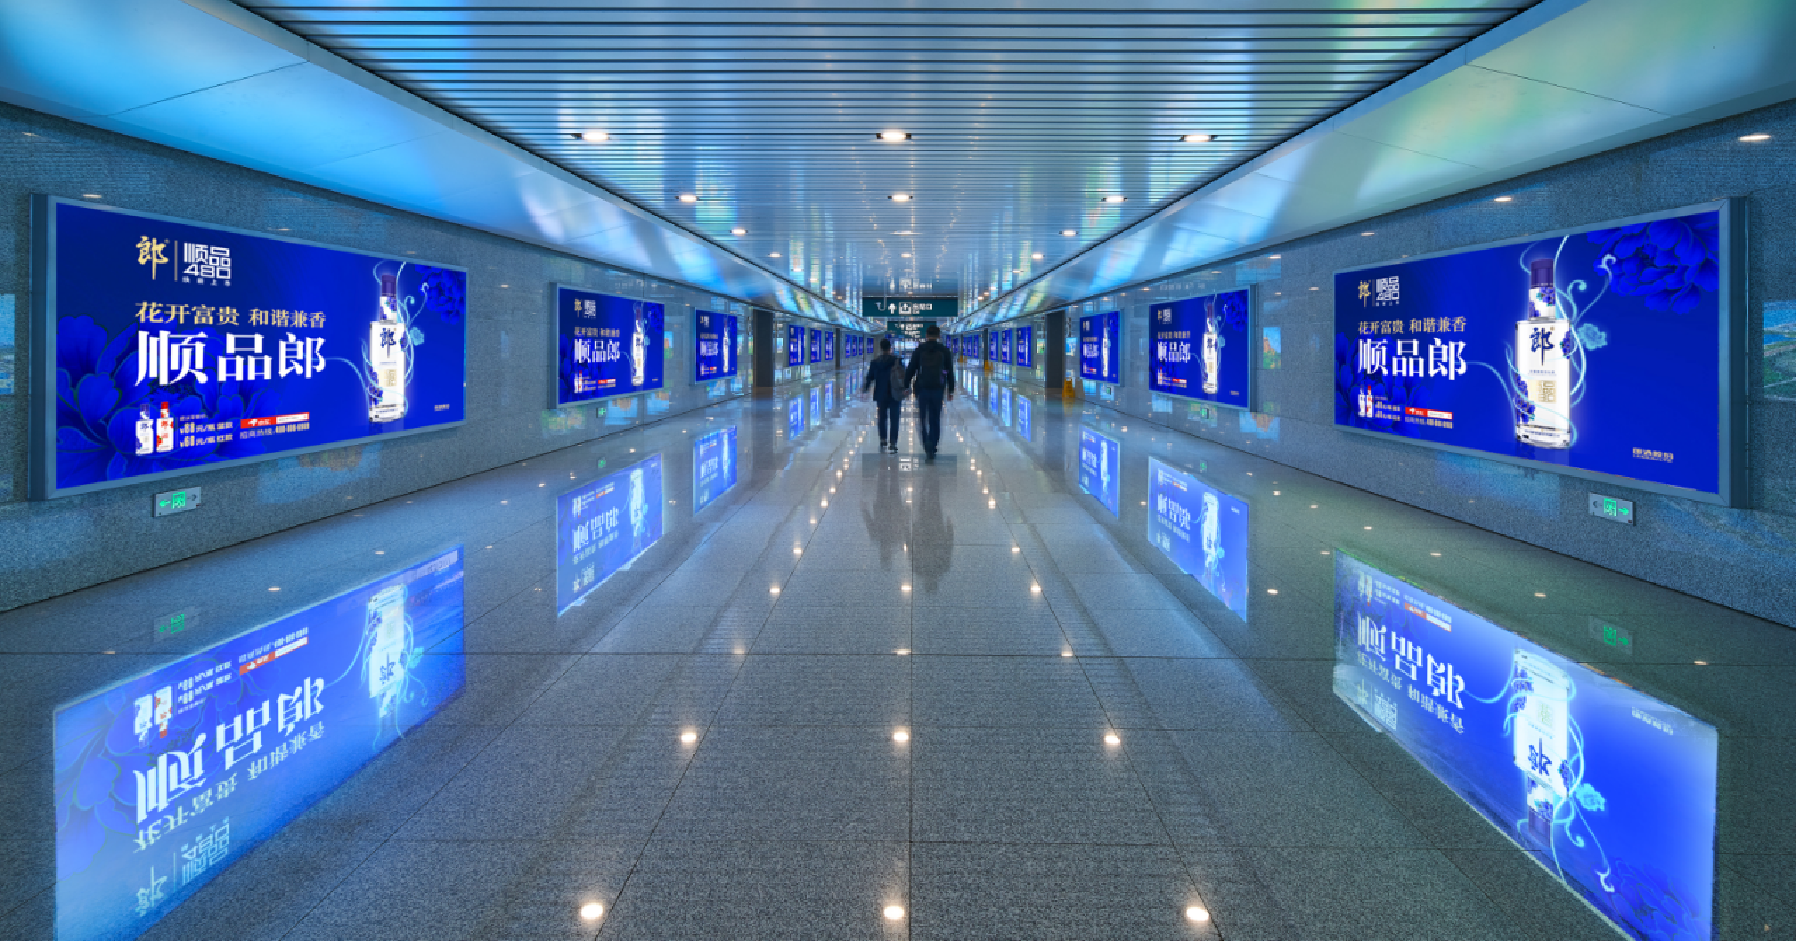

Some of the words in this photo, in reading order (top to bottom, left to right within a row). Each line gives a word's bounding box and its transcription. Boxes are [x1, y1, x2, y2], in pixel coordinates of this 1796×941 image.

[136, 236, 168, 280] 郎
[183, 243, 230, 265] 顺品
[182, 264, 230, 279] 480
[135, 301, 240, 326] 花开富贵
[247, 308, 327, 329] 和谐兼香
[1358, 319, 1404, 335] 花开富贵
[1409, 316, 1467, 334] 和谐兼香
[135, 329, 327, 387] 顺品郎
[1358, 338, 1467, 381] 顺品郎
